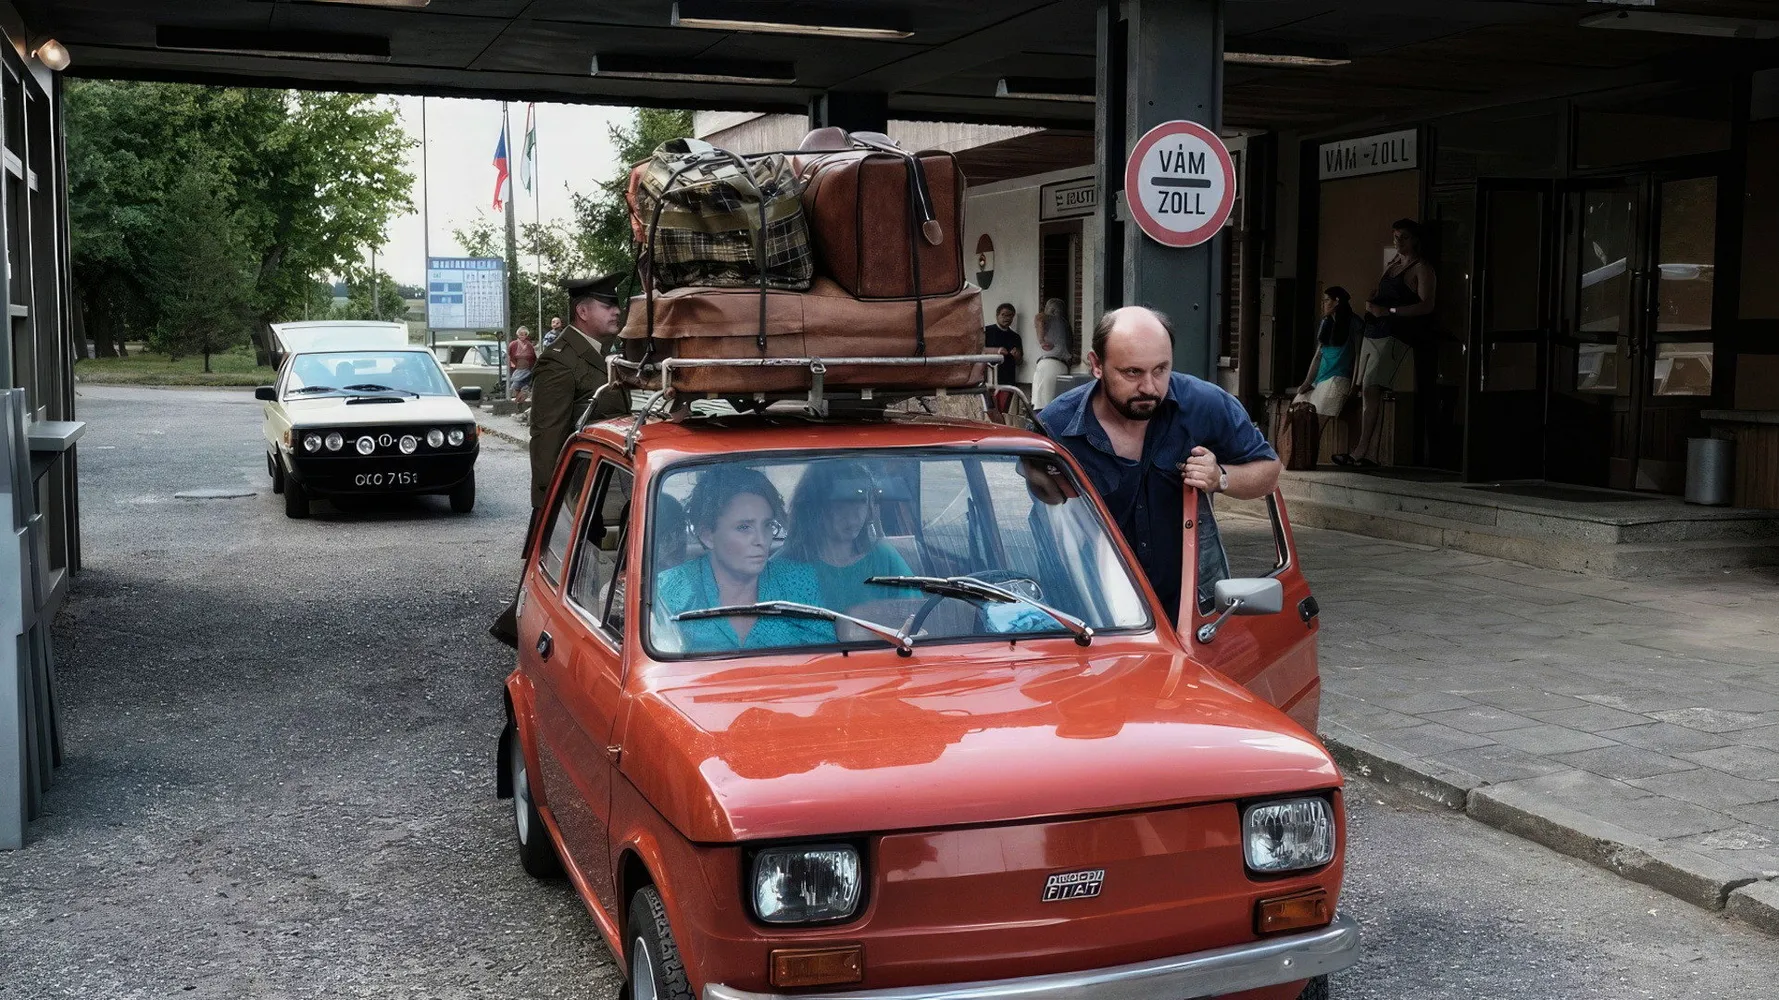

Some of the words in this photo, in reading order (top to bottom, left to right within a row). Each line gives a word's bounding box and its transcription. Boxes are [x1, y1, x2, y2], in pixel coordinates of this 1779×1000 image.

[1159, 143, 1205, 174] VÁM
[1371, 138, 1409, 166] ZOLL
[1158, 190, 1205, 215] ZOLL
[1047, 882, 1099, 899] FIAT
